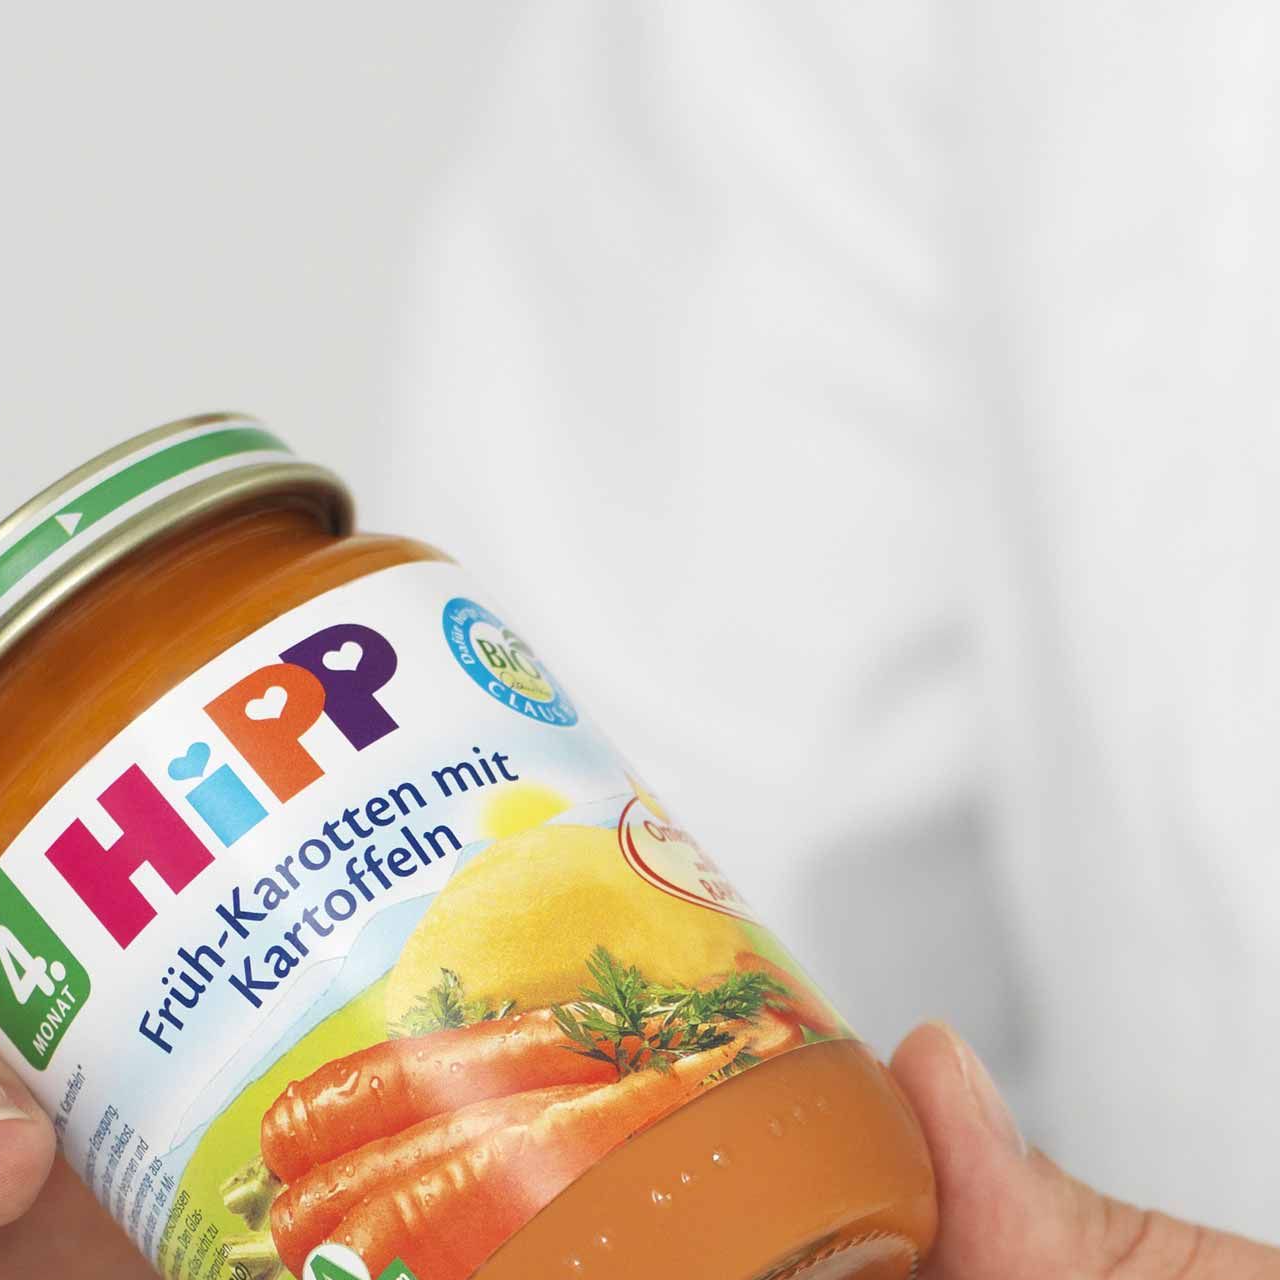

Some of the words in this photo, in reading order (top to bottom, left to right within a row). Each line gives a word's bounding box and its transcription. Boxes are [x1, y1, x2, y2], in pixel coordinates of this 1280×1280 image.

[476, 639, 541, 680] BIO
[488, 681, 567, 722] CLAUS
[44, 622, 401, 951] HiPP
[139, 782, 427, 1053] Früh-Karotten
[432, 746, 519, 797] mit
[228, 824, 462, 1008] Kartoffeln
[32, 985, 76, 1056] MONAT
[133, 1136, 150, 1160] und
[147, 1154, 163, 1176] aus
[159, 1170, 176, 1192] Mi-
[176, 1228, 192, 1249] Den
[184, 1208, 203, 1232] Glas-
[196, 1232, 212, 1260] nicht
[207, 1224, 219, 1240] zu
